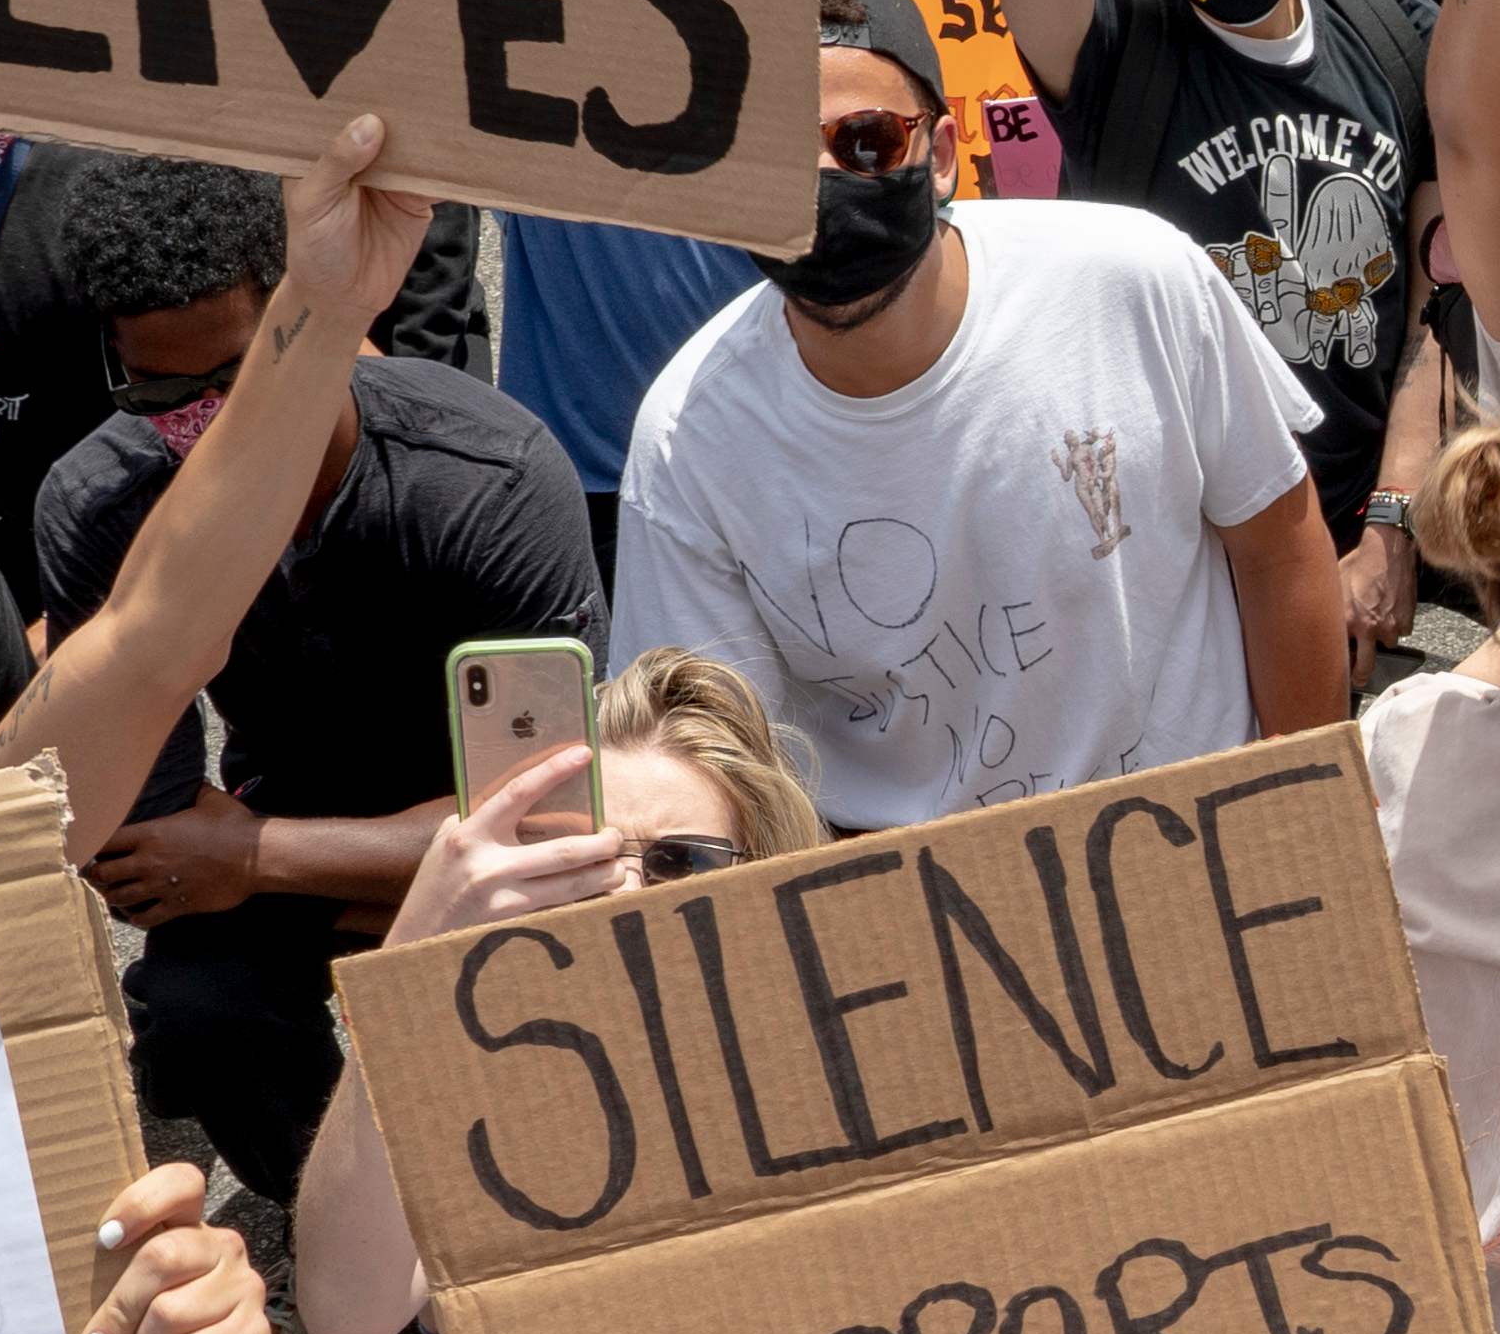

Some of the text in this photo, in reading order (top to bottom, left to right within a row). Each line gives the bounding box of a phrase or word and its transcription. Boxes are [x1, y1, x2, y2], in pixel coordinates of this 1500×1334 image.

[984, 103, 1040, 145] BE
[1177, 112, 1408, 199] WELCOME TO
[739, 513, 939, 660] NO
[942, 713, 1017, 798] NO
[452, 762, 1360, 1232] SILENCE
